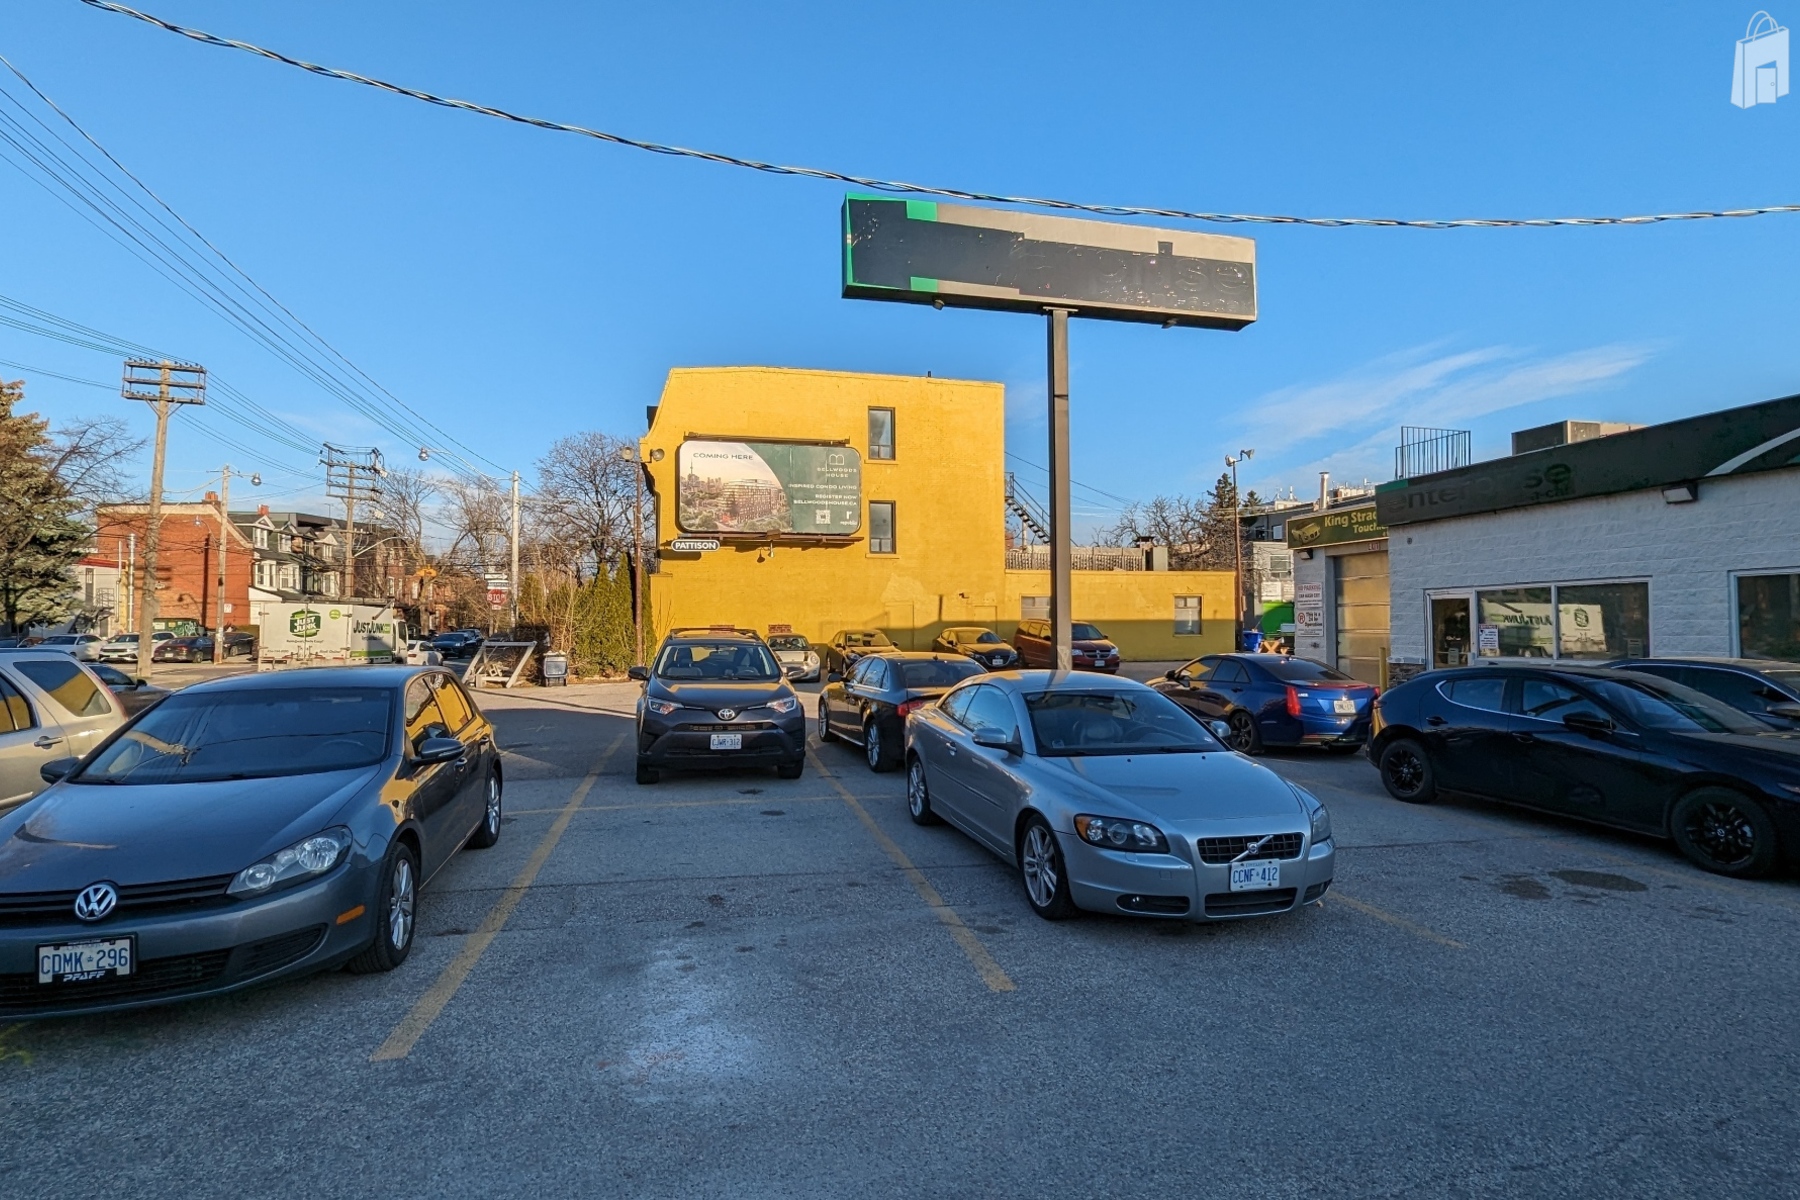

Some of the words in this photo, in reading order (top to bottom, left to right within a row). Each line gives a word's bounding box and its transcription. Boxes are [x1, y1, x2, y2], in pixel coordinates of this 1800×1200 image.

[1324, 515, 1349, 528] King
[675, 542, 717, 550] PATTISON
[487, 593, 506, 601] STOP
[294, 617, 316, 626] JUST
[294, 623, 317, 633] JUNK
[1232, 867, 1256, 884] CCNF
[1260, 866, 1279, 882] 412
[40, 951, 84, 975] CDMK
[96, 947, 129, 970] 296
[63, 970, 106, 982] PFAFF
